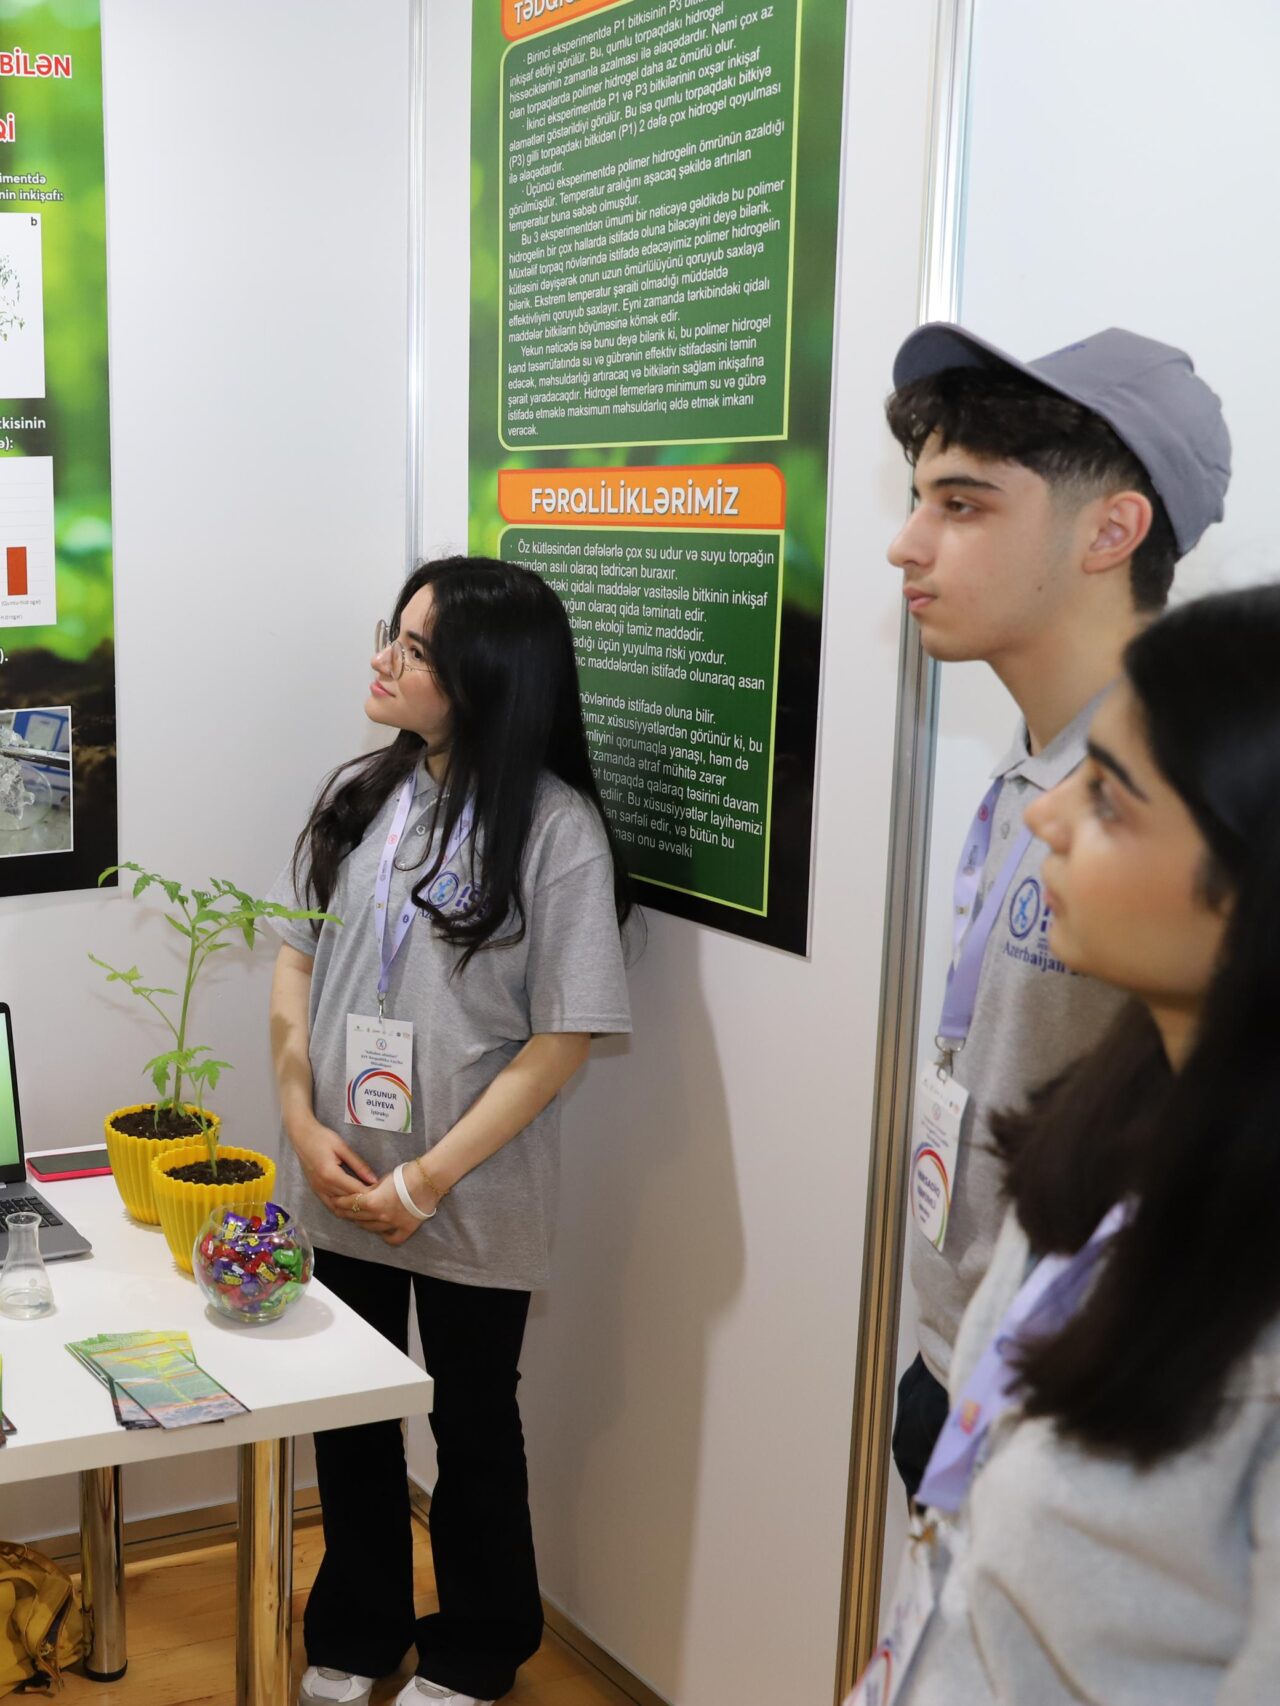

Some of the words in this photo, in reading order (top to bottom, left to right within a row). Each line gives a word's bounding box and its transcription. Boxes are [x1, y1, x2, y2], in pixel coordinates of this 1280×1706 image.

[0, 48, 72, 77] BİLƏN
[19, 188, 64, 202] inkişafı:
[30, 216, 39, 227] b
[521, 344, 543, 357] Yekun
[545, 341, 578, 354] nəticədə
[580, 339, 592, 351] isə
[594, 337, 614, 349] bunu
[616, 334, 637, 348] deyə
[639, 330, 665, 343] bilərik
[667, 327, 677, 340] ki,
[680, 325, 692, 338] bu
[694, 321, 729, 339] polimer
[731, 314, 771, 333] hidrogel
[531, 479, 740, 516] FƏRQLİLİKLƏRİMİZ
[518, 538, 530, 554] Öz
[532, 543, 582, 557] kütləsindən
[583, 545, 623, 557] dəfələrlə
[626, 549, 643, 561] çox
[645, 549, 657, 558] su
[660, 548, 683, 561] udur
[685, 550, 698, 560] və
[700, 551, 726, 564] suyu
[729, 550, 775, 567] torpağın
[549, 560, 568, 573] asılı
[570, 562, 597, 576] olaraq
[600, 564, 638, 577] tədricən
[640, 566, 678, 580] buraxır.
[570, 580, 595, 595] qidalı
[597, 582, 642, 596] maddələr
[643, 585, 690, 600] vasitəsilə
[692, 588, 729, 604] bitkinin
[731, 591, 769, 610] inkişaf
[588, 601, 617, 617] olaraq
[619, 603, 640, 618] qida
[642, 605, 682, 620] təminatı
[684, 609, 707, 623] edir.
[595, 620, 624, 637] ekoloji
[626, 622, 653, 637] təmiz
[655, 626, 705, 642] maddədir.
[597, 637, 620, 653] üçün
[622, 642, 663, 660] yuyulma
[665, 644, 686, 660] riski
[688, 649, 727, 666] yoxdur.
[1003, 941, 1066, 973] Azerbaijan
[364, 1088, 397, 1100] AYSUNUR
